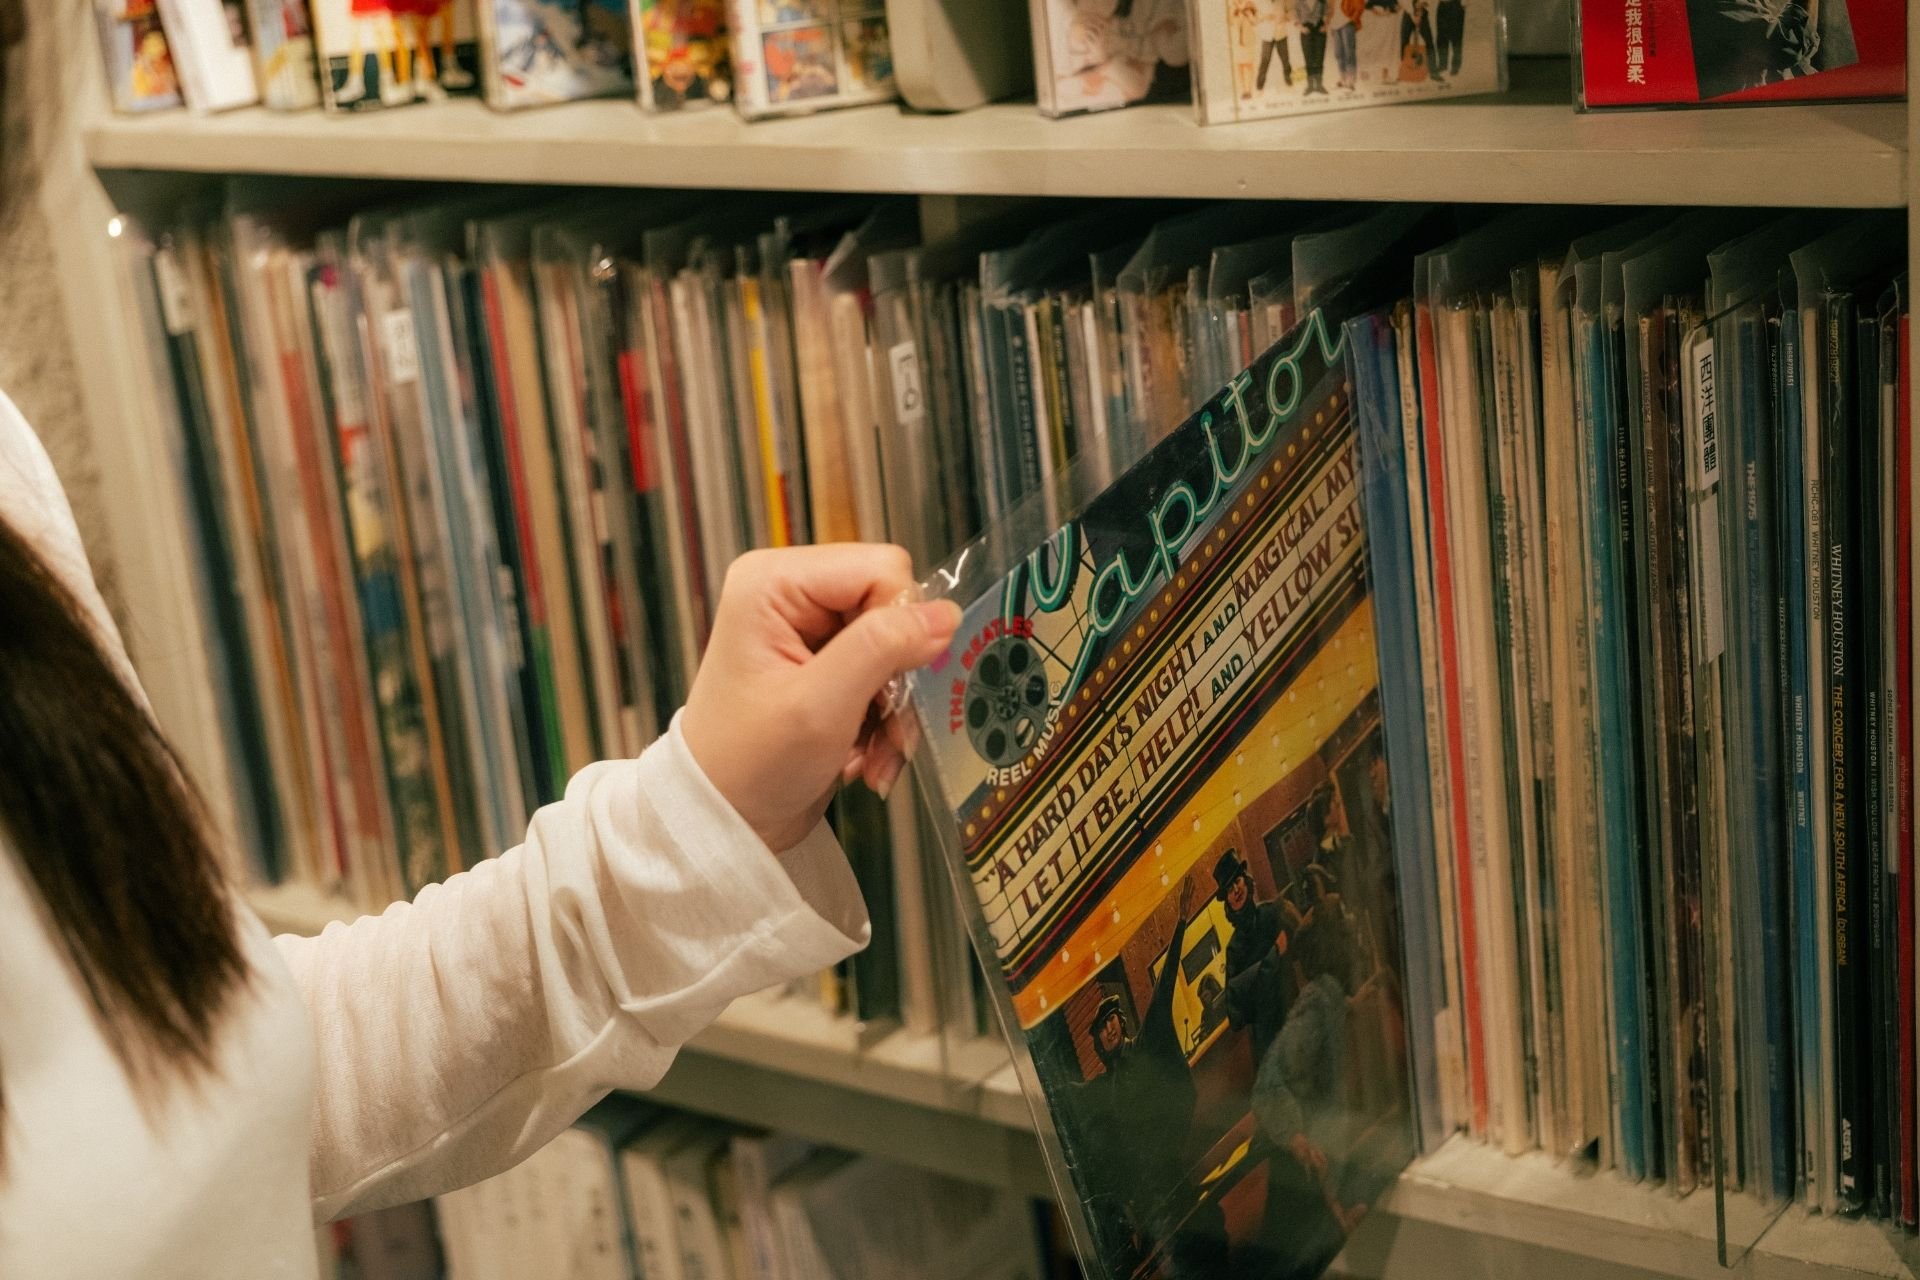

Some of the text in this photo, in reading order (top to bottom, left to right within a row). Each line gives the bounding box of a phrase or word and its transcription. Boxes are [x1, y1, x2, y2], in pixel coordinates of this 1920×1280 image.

[1810, 530, 1819, 573] WHITNEY
[1831, 543, 1843, 608] WHITNEY
[1811, 575, 1820, 621] HOUSTON
[1832, 610, 1844, 676] HOUSTON
[950, 616, 1034, 734] THE BEATLES
[1014, 783, 1076, 867] HARD
[1132, 633, 1200, 727] NIGHT
[1202, 601, 1239, 652] AND
[1233, 493, 1325, 606] MAGICAL
[1833, 685, 1844, 708] THE
[986, 680, 1064, 787] REEL MUSIC
[1020, 849, 1066, 919] LET
[1069, 816, 1092, 864] IT
[1091, 778, 1140, 835] BE,
[1136, 684, 1205, 784] HELP!
[1209, 653, 1245, 703] AND
[1241, 529, 1333, 657] YELLOW
[1833, 709, 1844, 765] CONCERT
[1794, 695, 1806, 828] WHITNEY HOUSTON WHITNEY
[1834, 767, 1845, 790] FOR
[1835, 802, 1846, 829] NEW
[1836, 831, 1847, 869] SOUTH
[1836, 871, 1847, 912] AFRICA
